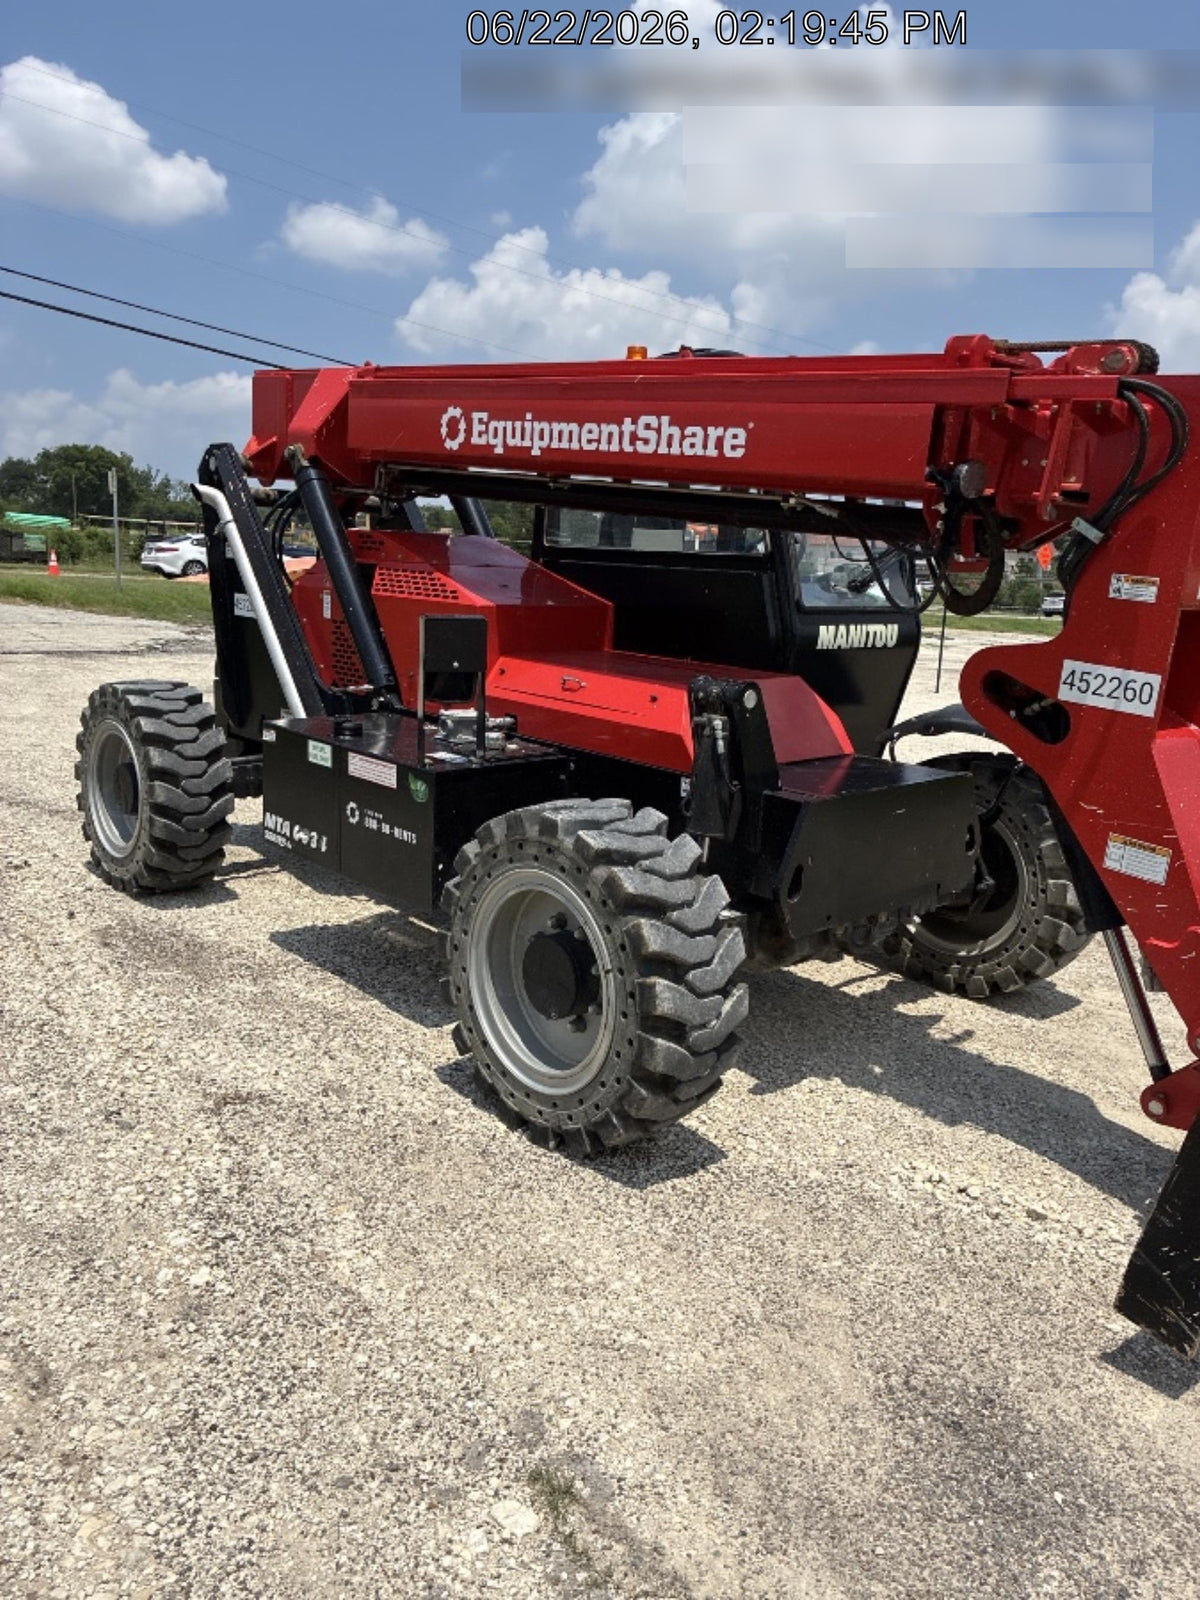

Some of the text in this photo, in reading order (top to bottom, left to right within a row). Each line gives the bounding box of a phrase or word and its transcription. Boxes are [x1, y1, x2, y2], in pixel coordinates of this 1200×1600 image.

[470, 411, 748, 458] EquipmentShare
[815, 623, 900, 650] MANITOU
[1061, 668, 1155, 706] 452260
